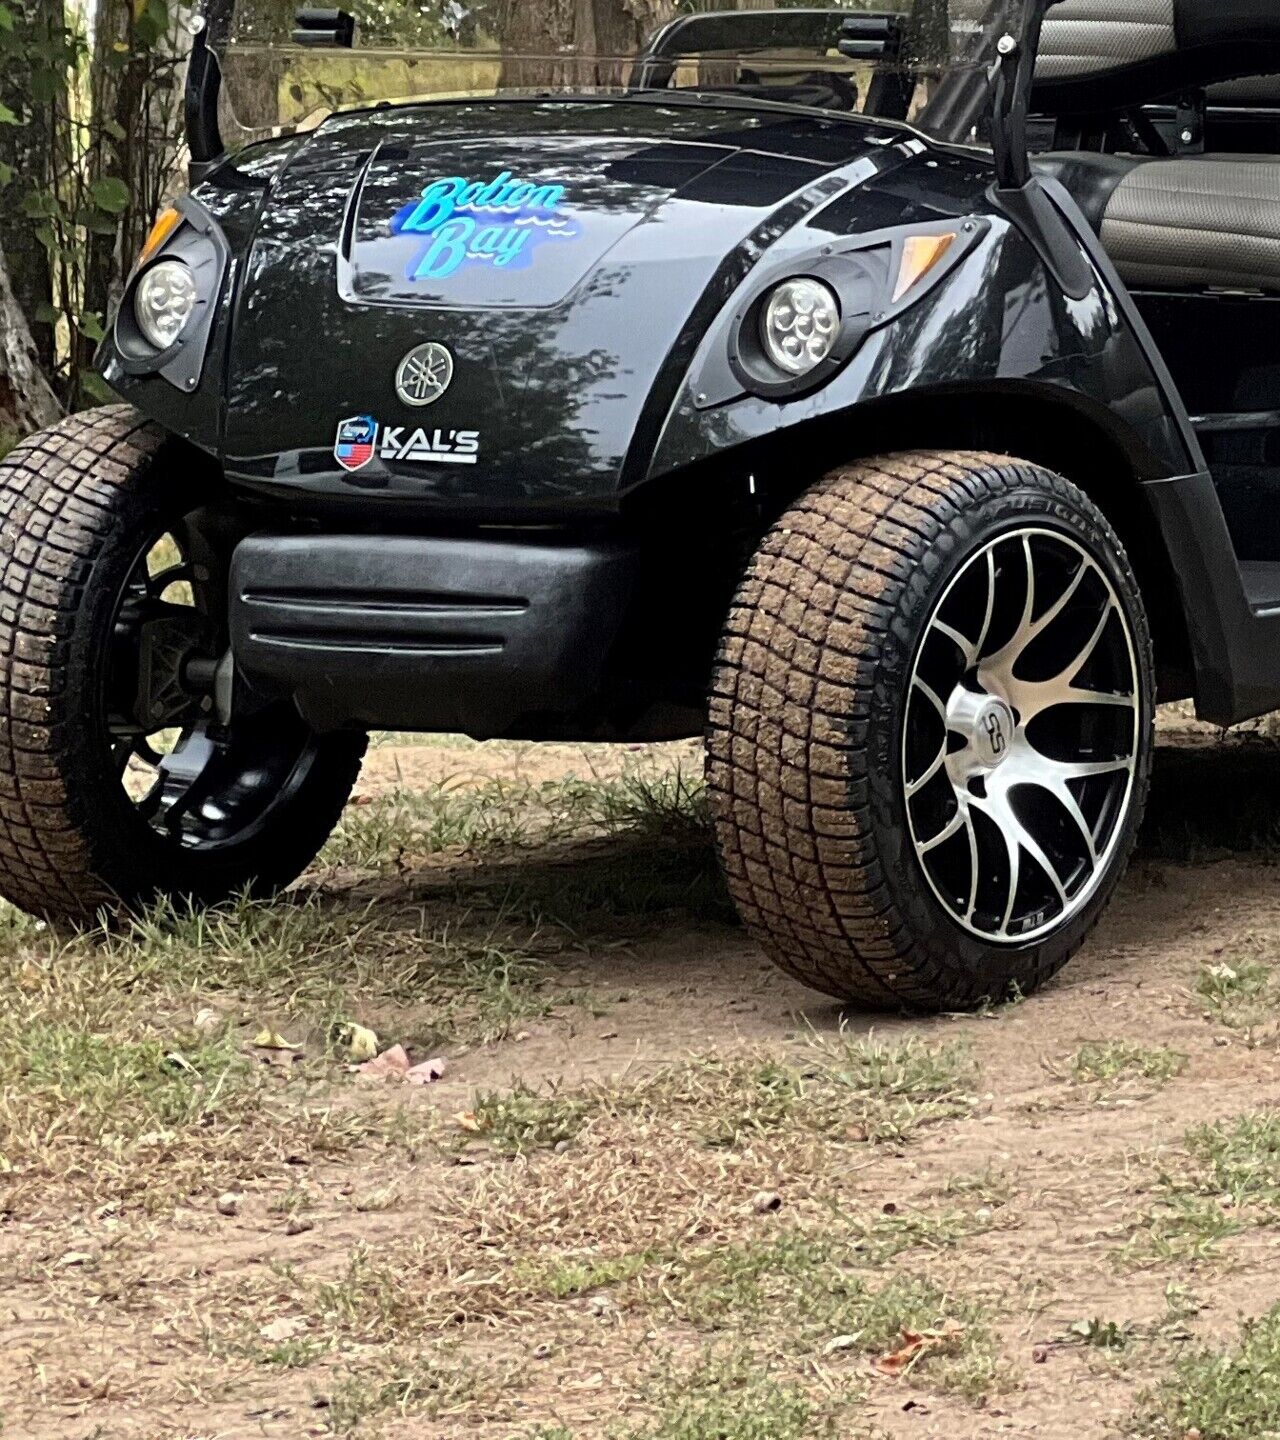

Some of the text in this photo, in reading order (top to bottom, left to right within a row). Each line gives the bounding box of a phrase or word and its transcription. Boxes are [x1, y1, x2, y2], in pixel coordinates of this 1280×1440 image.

[400, 170, 565, 231] Bolton
[414, 216, 533, 279] Bay
[382, 426, 480, 458] KAL'S
